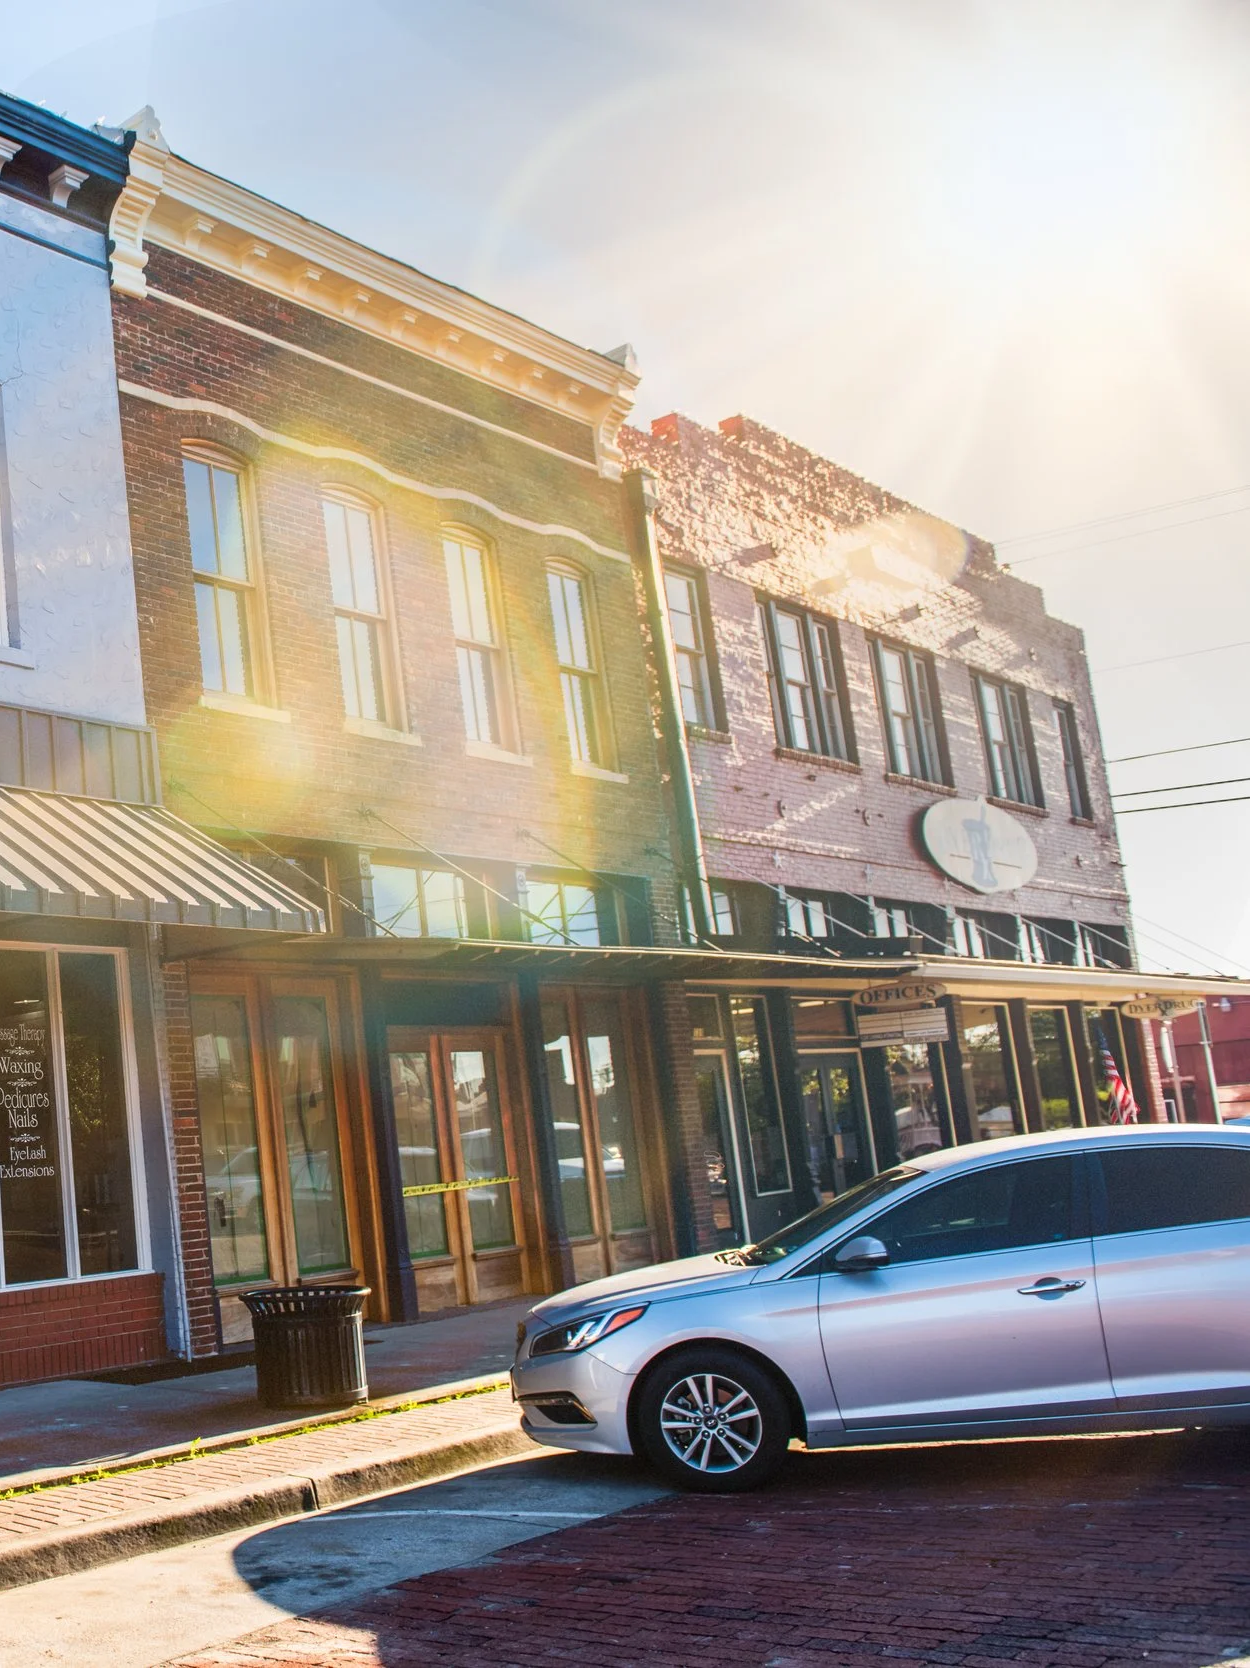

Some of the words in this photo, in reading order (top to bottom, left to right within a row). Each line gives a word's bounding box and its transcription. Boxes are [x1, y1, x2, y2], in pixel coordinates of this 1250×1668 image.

[860, 984, 936, 1004] OFFICES
[19, 1023, 45, 1047] Therapy
[8, 1108, 39, 1129] Nails
[0, 1164, 55, 1179] Extensions
